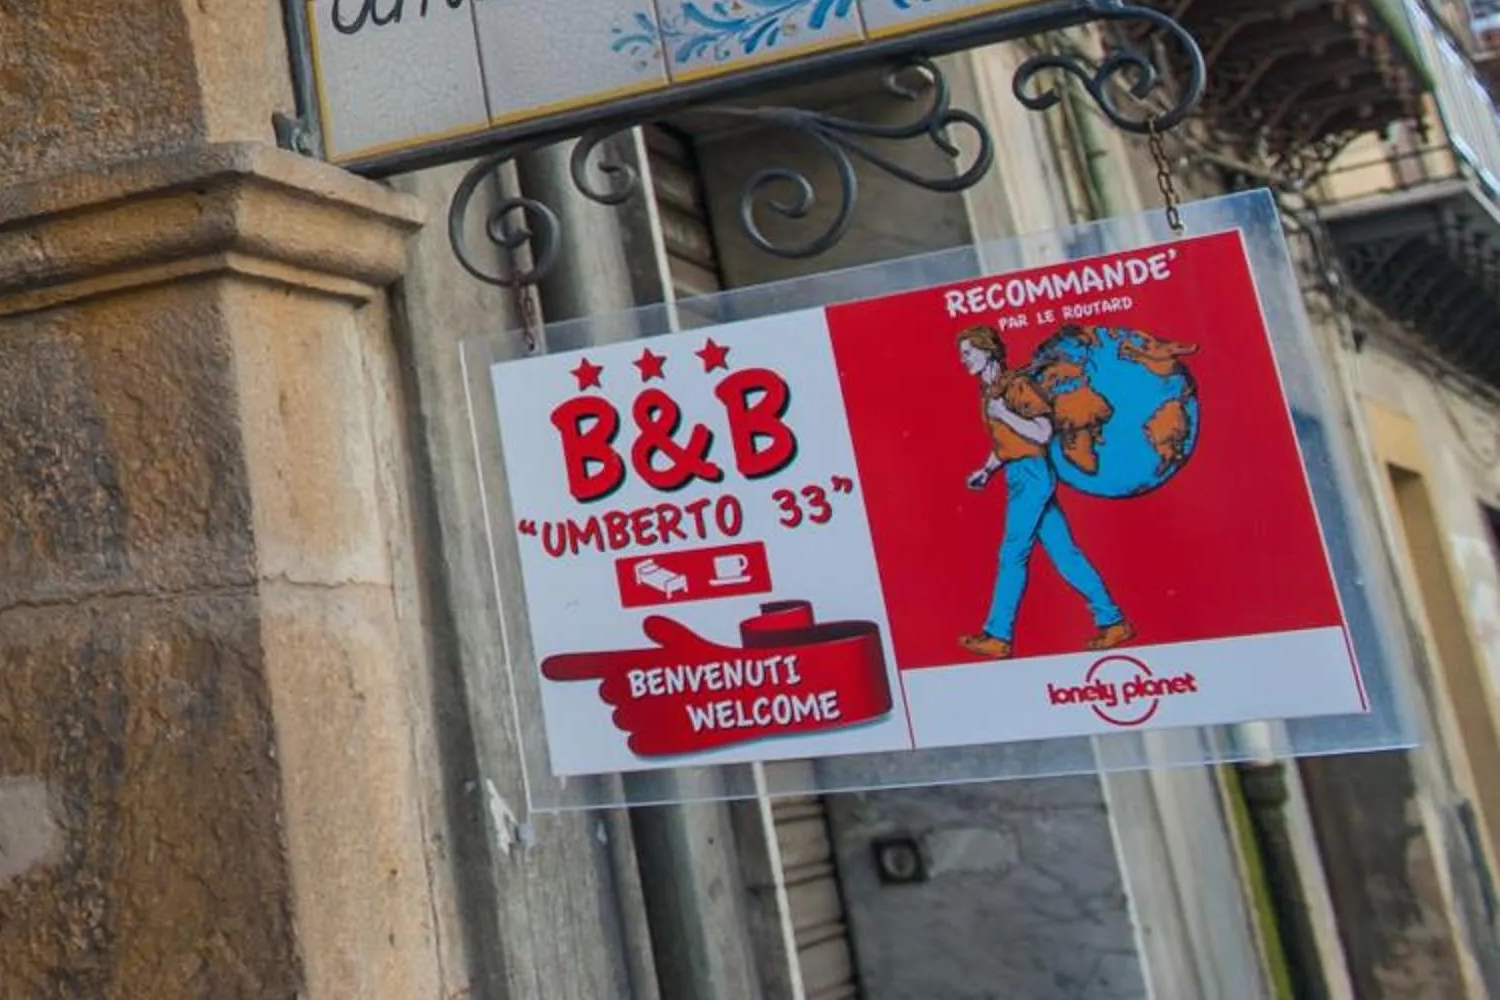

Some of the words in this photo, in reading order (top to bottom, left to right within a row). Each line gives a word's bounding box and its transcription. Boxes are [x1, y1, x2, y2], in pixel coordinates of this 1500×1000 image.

[998, 313, 1029, 331] PAR
[1036, 309, 1055, 325] LE
[1062, 296, 1133, 320] ROUTARD
[550, 367, 798, 502] B&B
[626, 653, 802, 699] BENVENUTI
[1047, 678, 1118, 707] lonely
[1122, 671, 1198, 704] planet
[684, 690, 841, 732] WELCOME
